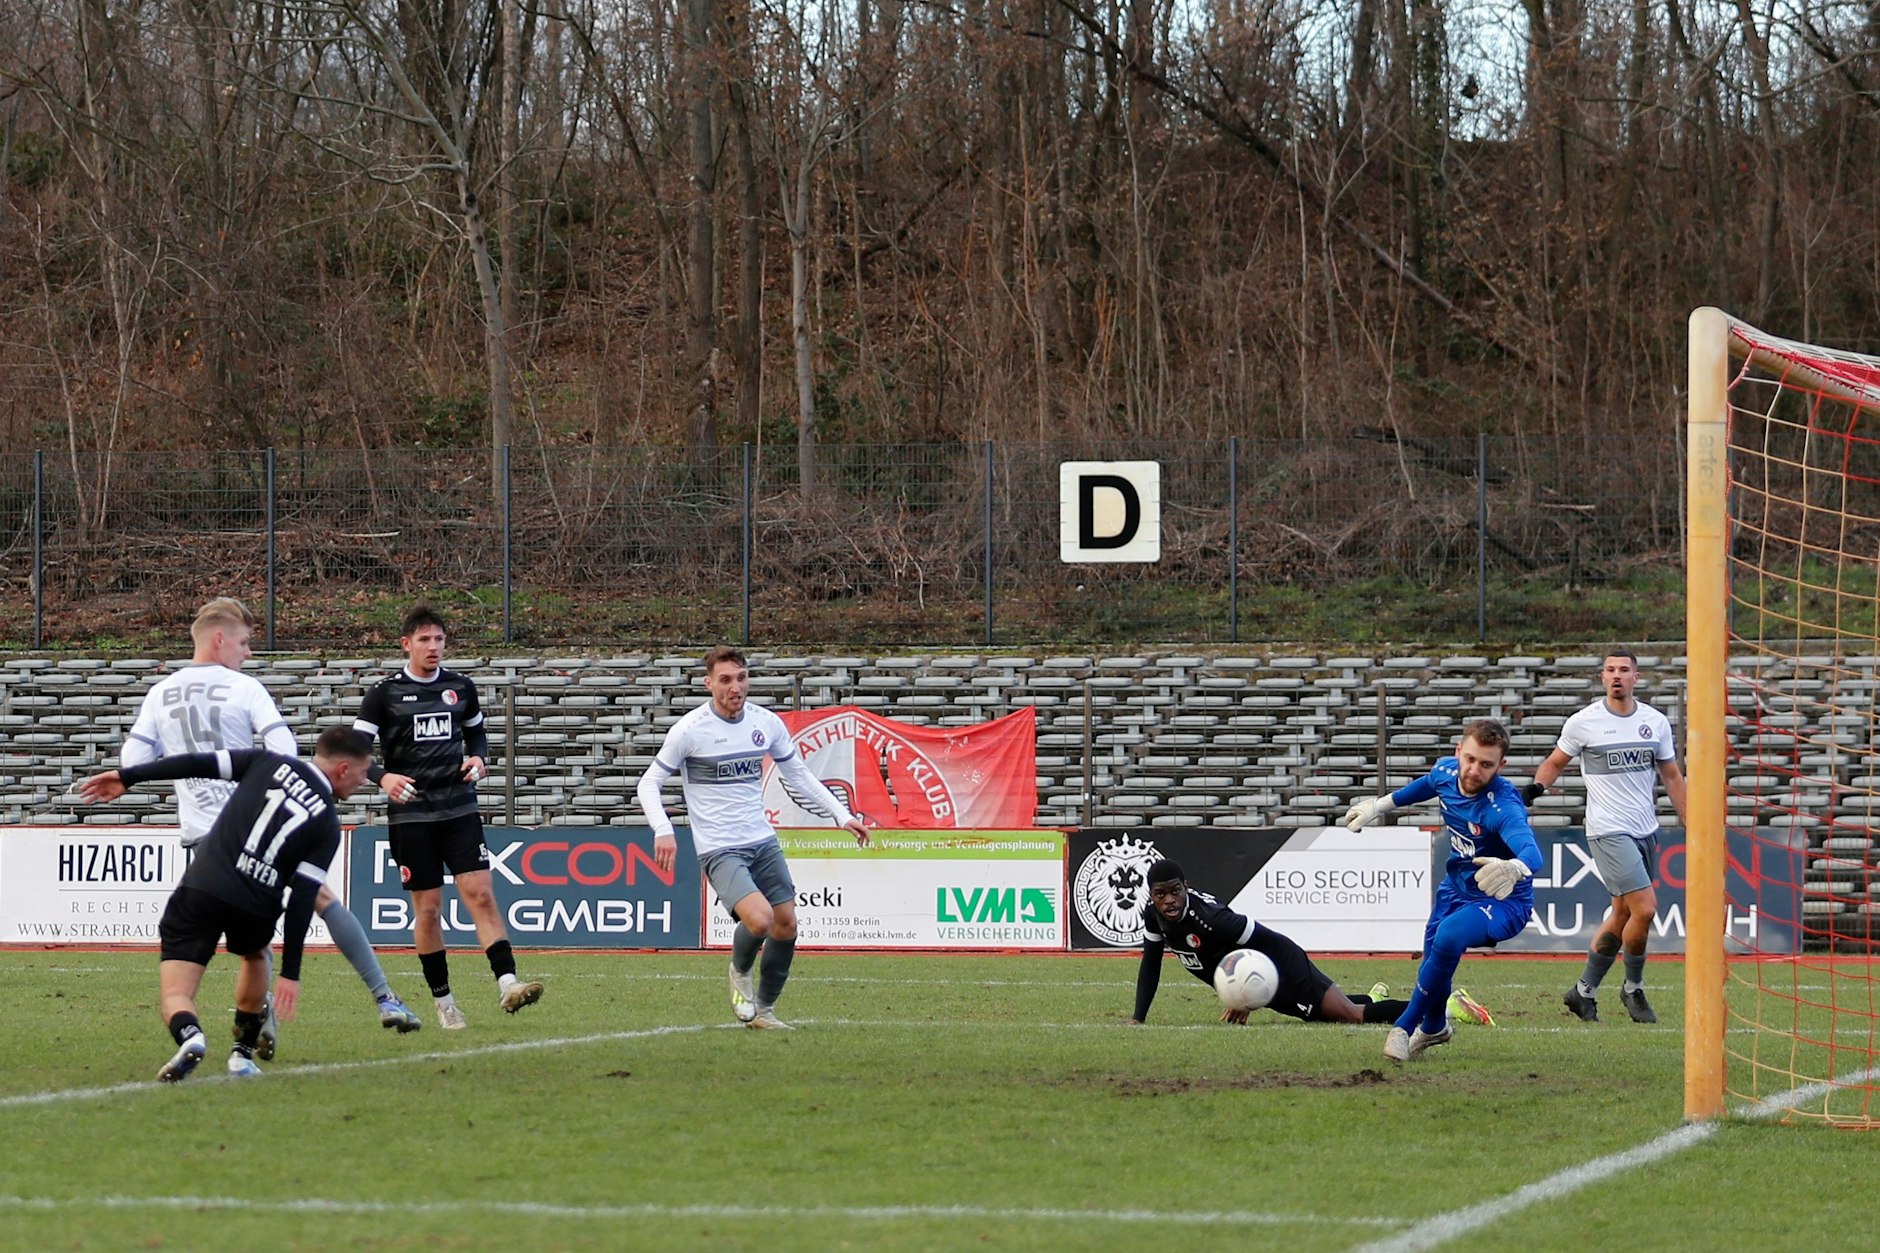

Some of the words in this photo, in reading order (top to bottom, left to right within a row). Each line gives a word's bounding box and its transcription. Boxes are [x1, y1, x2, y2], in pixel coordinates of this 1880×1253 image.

[1079, 475, 1140, 549] D
[163, 682, 231, 706] BFC
[169, 705, 224, 751] 14
[799, 717, 903, 763] ATHLETIK
[906, 757, 951, 820] KLUB
[272, 762, 328, 818] BERLIN
[243, 787, 309, 866] 17
[882, 839, 927, 851] Vorsorge
[931, 840, 950, 850] und
[955, 840, 1056, 852] Vermögensplanung
[58, 844, 163, 882] HIZARCI
[235, 852, 279, 887] MEYER
[1265, 871, 1306, 889] LEO
[1314, 870, 1425, 889] SECURITY
[72, 902, 159, 913] RECHTS
[937, 887, 1016, 922] LVM
[1265, 892, 1333, 905] SERVICE
[1336, 890, 1389, 904] GmbH
[508, 899, 671, 932] GMBH
[821, 917, 850, 926] 13359
[853, 917, 880, 926] Berlin
[808, 930, 820, 938] 30
[937, 928, 1056, 940] VERSICHERUNG
